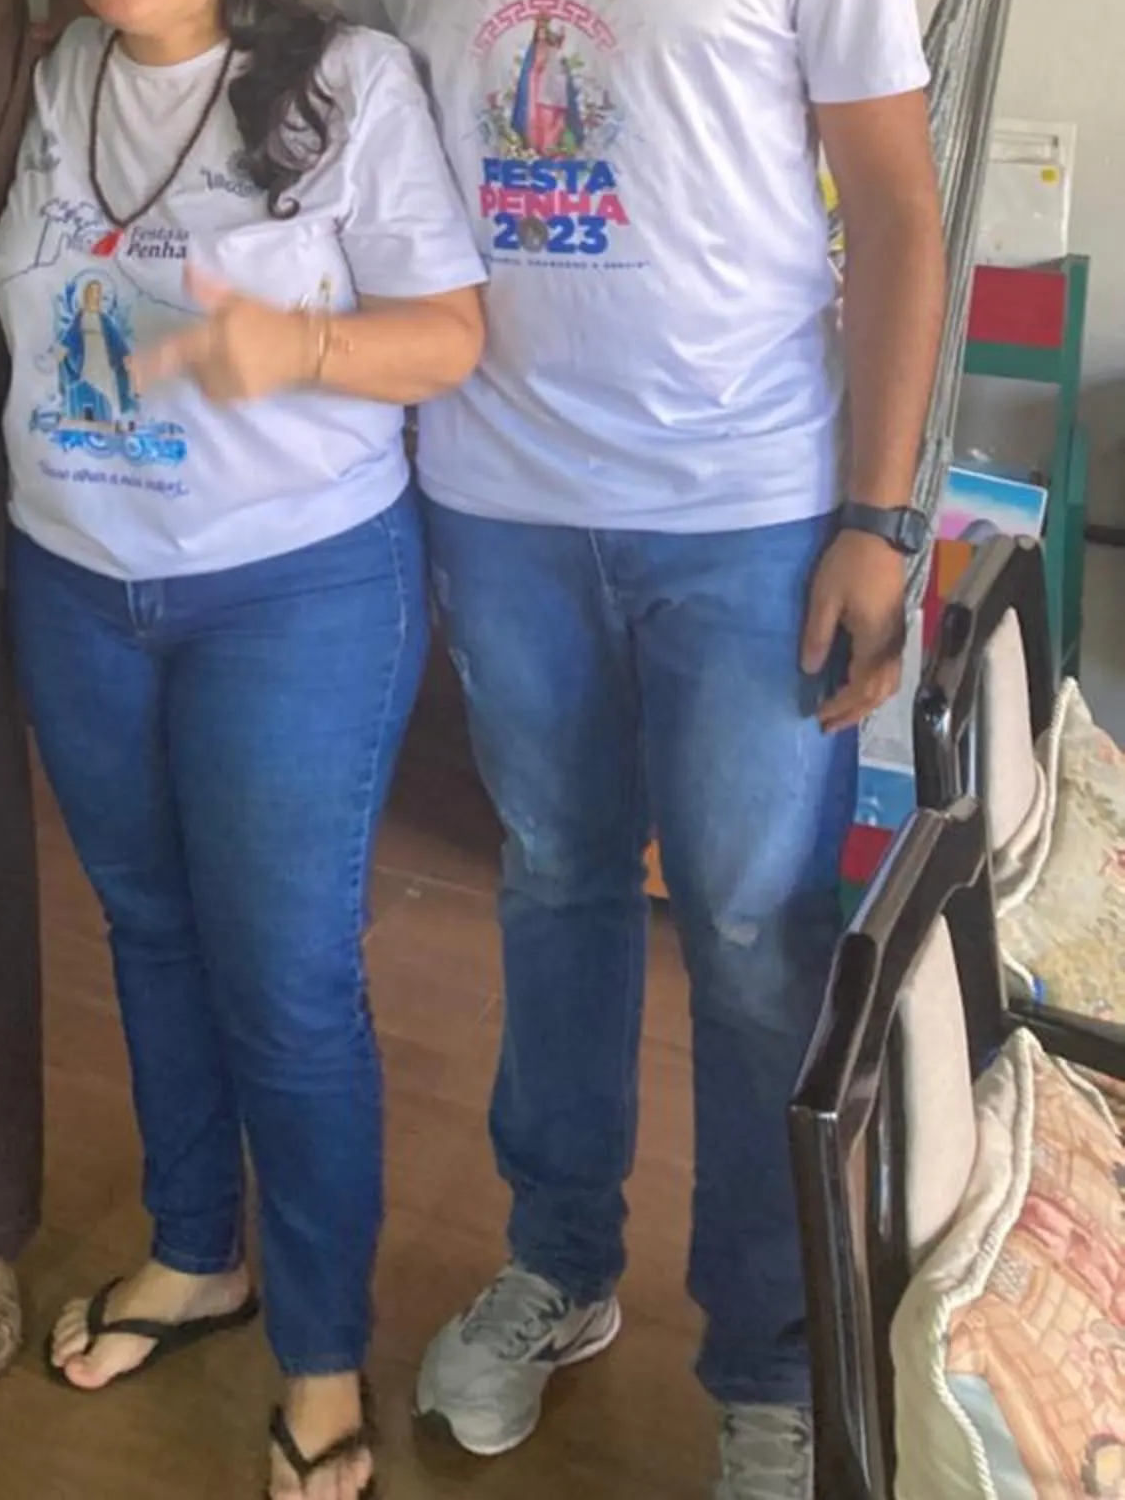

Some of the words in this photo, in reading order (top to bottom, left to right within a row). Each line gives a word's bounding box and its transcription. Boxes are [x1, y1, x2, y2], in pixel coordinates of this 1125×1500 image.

[482, 156, 617, 194] FESTA
[479, 183, 630, 226] PENHA
[126, 240, 187, 258] Penha
[493, 211, 608, 254] 2023
